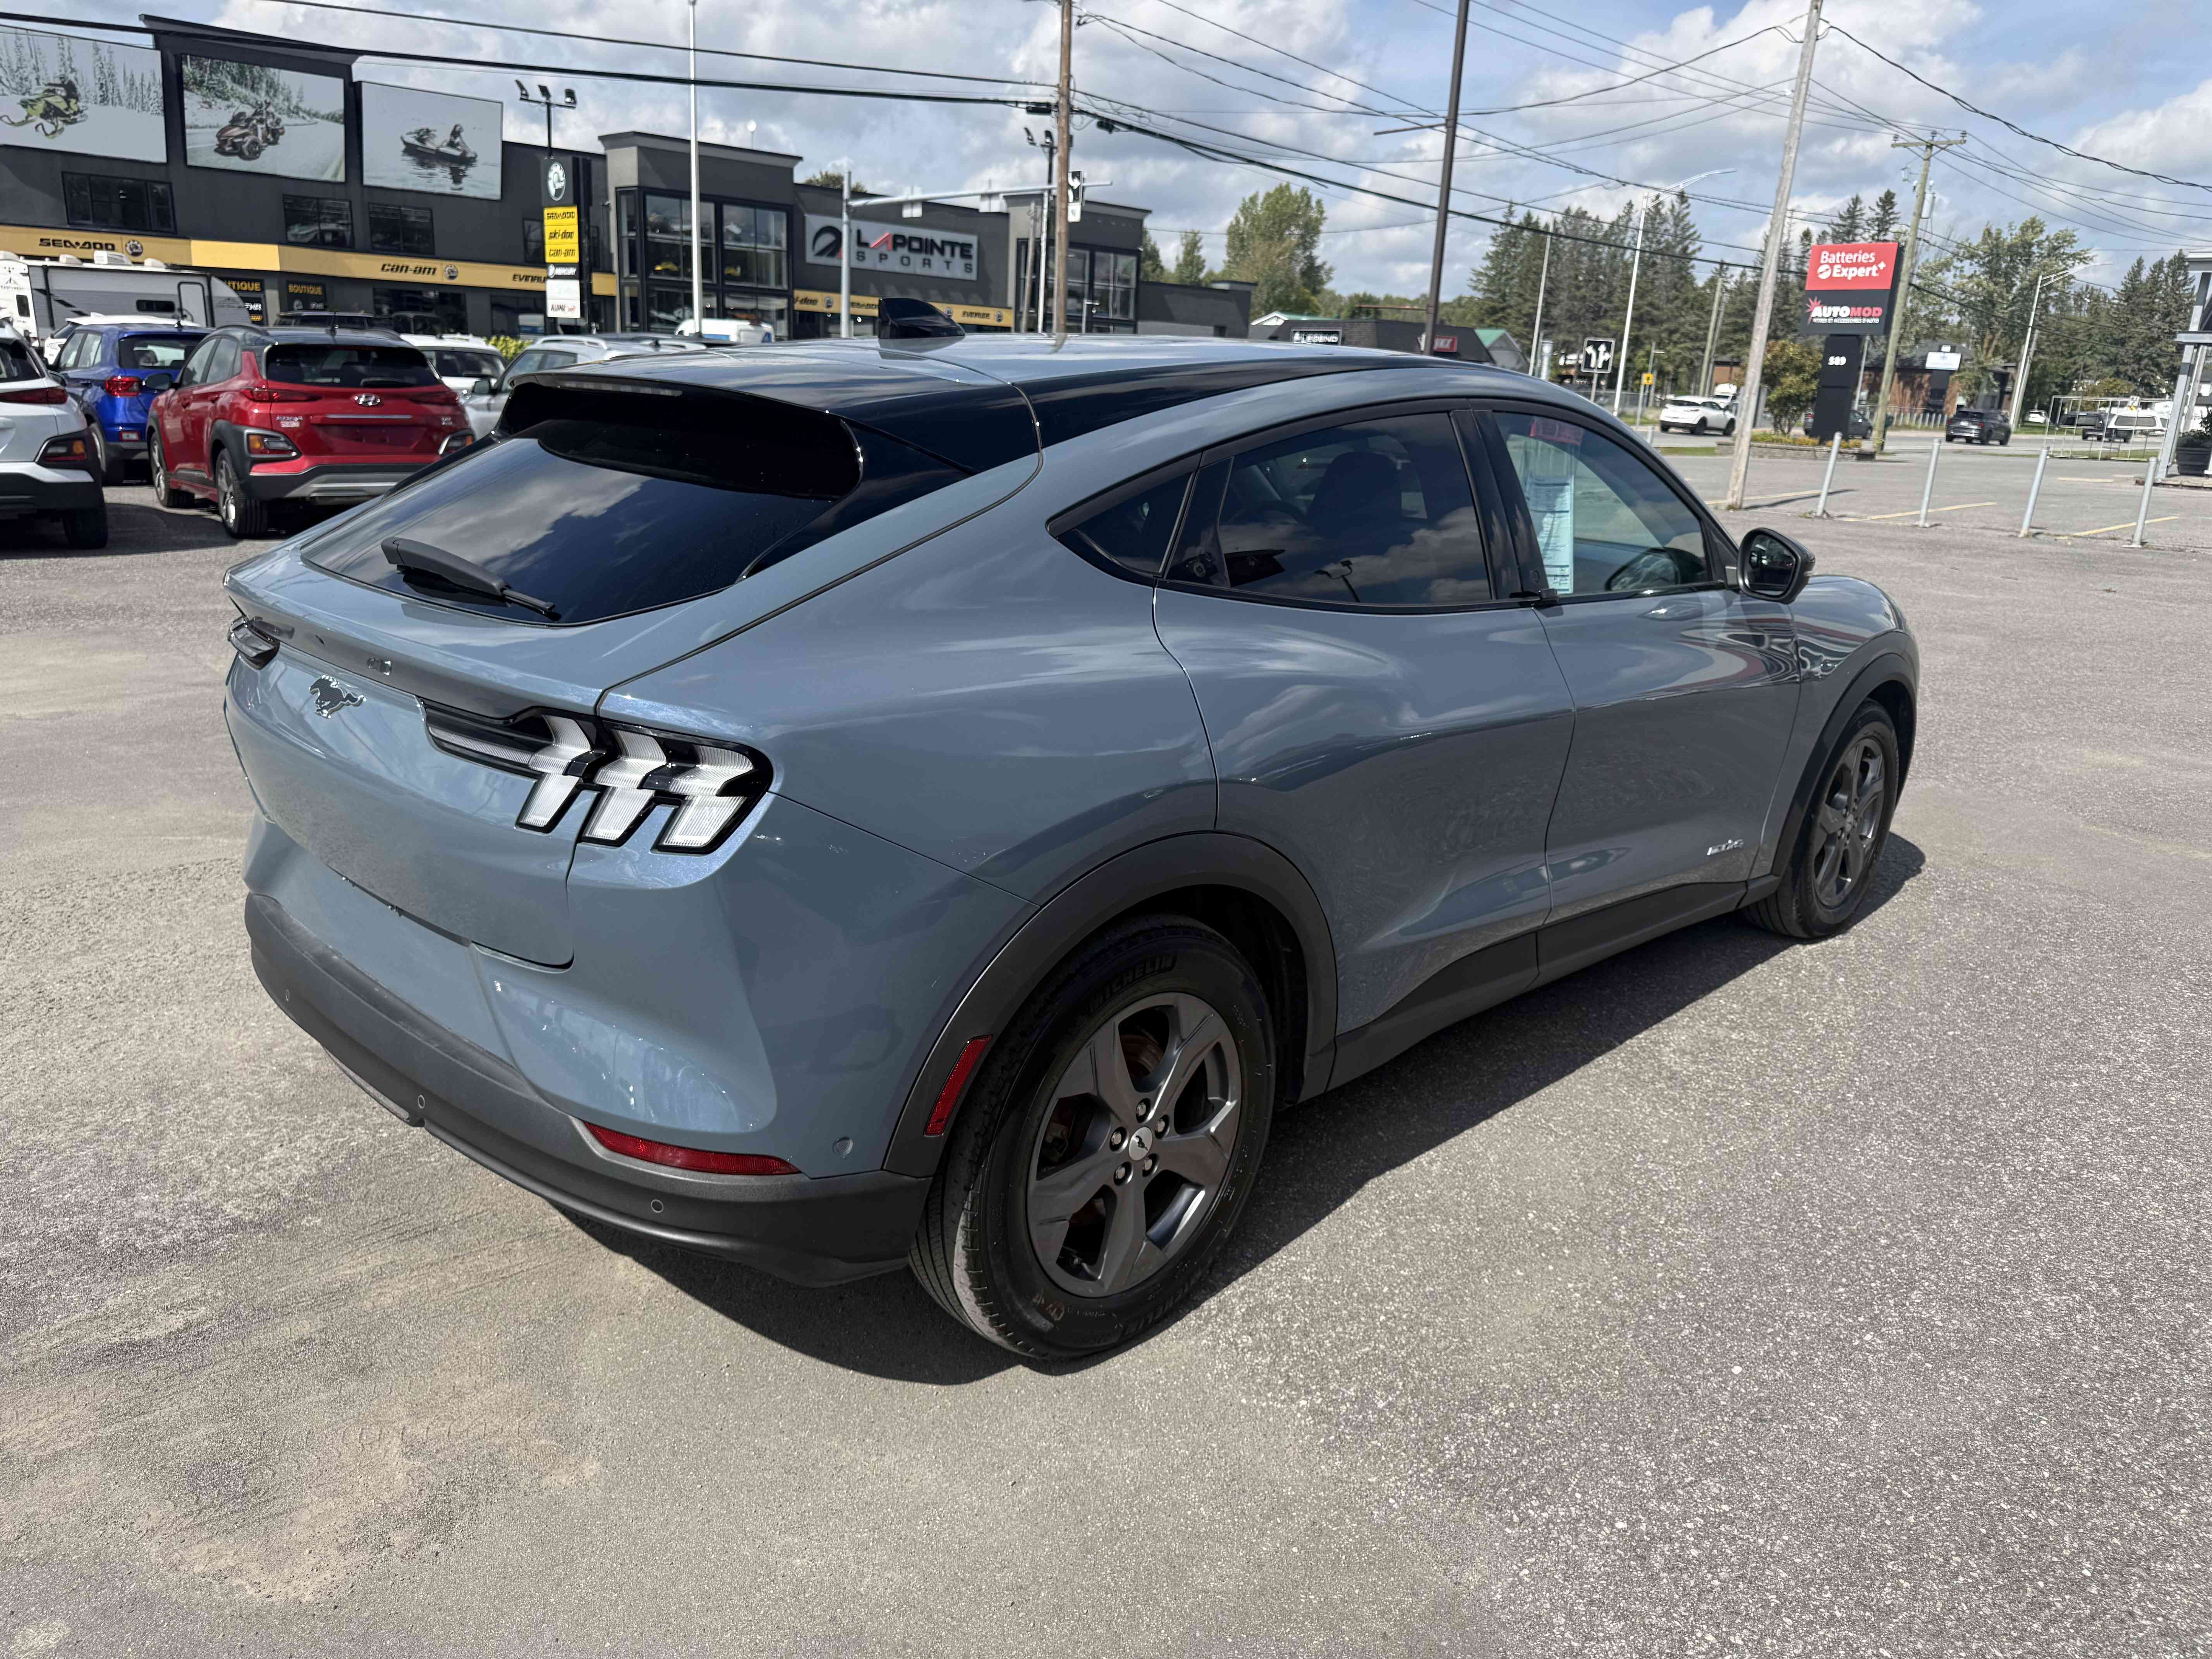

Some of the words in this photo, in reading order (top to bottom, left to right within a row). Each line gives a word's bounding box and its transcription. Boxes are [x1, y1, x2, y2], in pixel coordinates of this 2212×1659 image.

[856, 230, 973, 260] LAPOINTE
[856, 251, 973, 273] SPORTS
[1820, 250, 1876, 264] Batteries
[381, 263, 437, 275] can-am
[513, 274, 546, 283] EVINRU
[1812, 306, 1883, 317] AUTOMOD
[1828, 356, 1846, 366] 589
[1089, 954, 1177, 1012] MICHELIN
